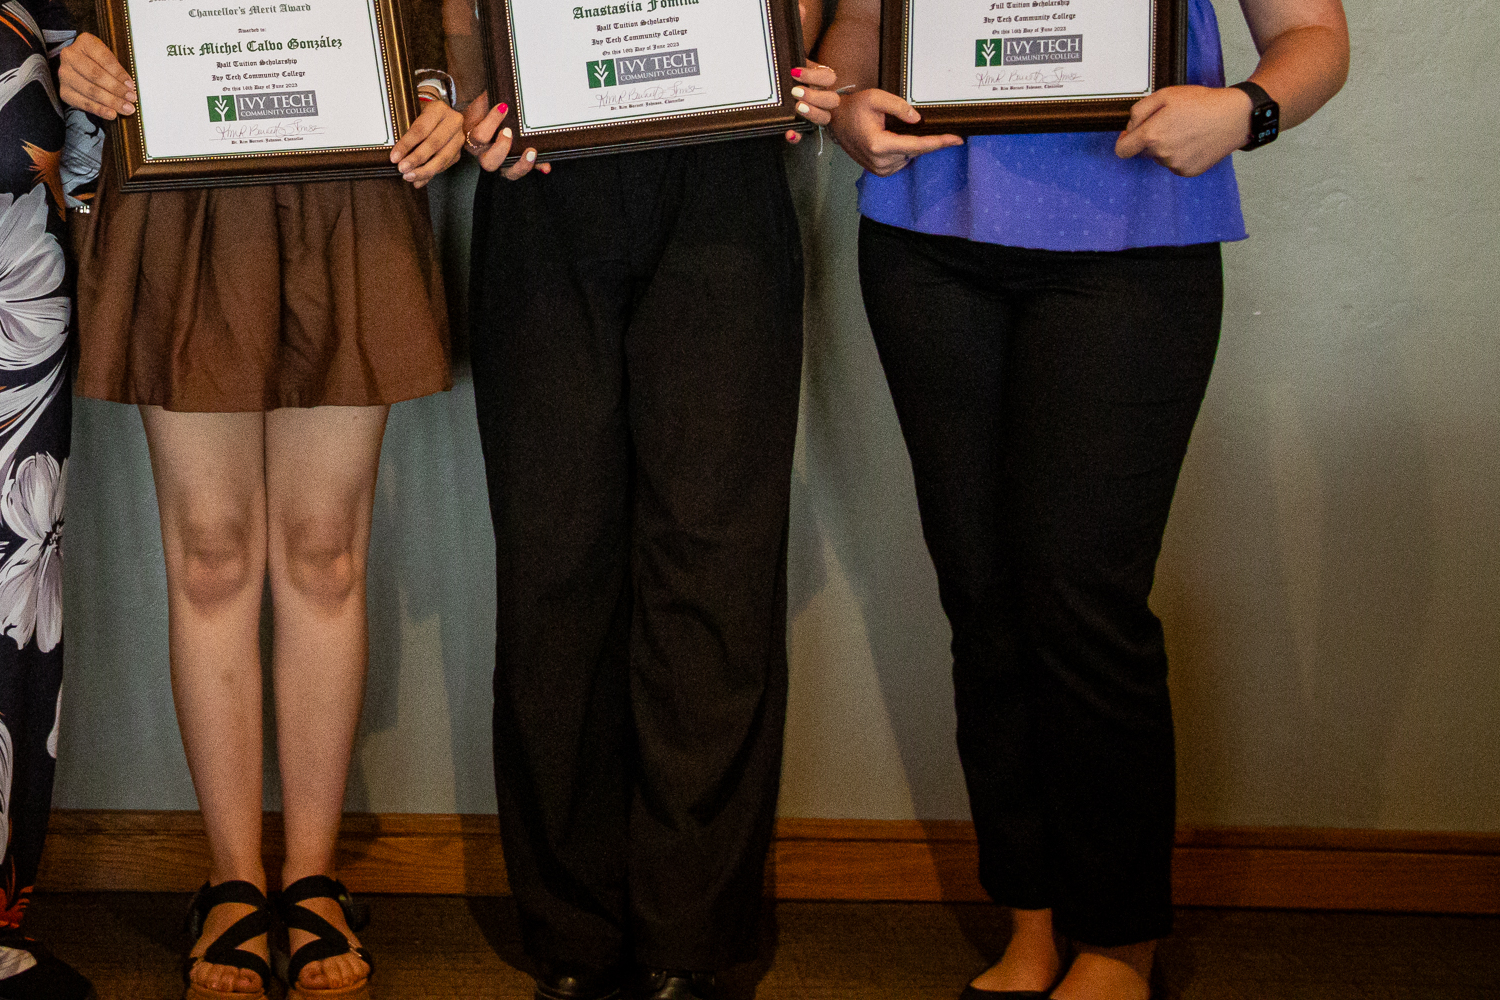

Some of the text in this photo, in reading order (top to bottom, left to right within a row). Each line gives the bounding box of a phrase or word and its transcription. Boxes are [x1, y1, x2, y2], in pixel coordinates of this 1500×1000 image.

[248, 5, 276, 15] Merit
[279, 3, 311, 12] Award
[572, 0, 642, 19] Anastasiia
[989, 2, 1004, 10] Full
[1032, 0, 1070, 7] Scholarship
[596, 16, 679, 32] Half Tuition Scholarship
[983, 16, 995, 24] Ivy
[1013, 14, 1050, 22] Community
[605, 36, 621, 44] Tech
[623, 32, 661, 41] Community
[166, 35, 342, 56] Alix Michel Calvo González
[1006, 38, 1078, 54] IVY TECH
[259, 58, 297, 66] Scholarship
[619, 52, 695, 73] IVY TECH
[1005, 52, 1079, 61] COMMUNITY COLLEGE
[620, 66, 696, 81] COMMUNITY COLLEGE
[238, 94, 313, 109] IVY TECH
[240, 108, 285, 117] COMMUNITY
